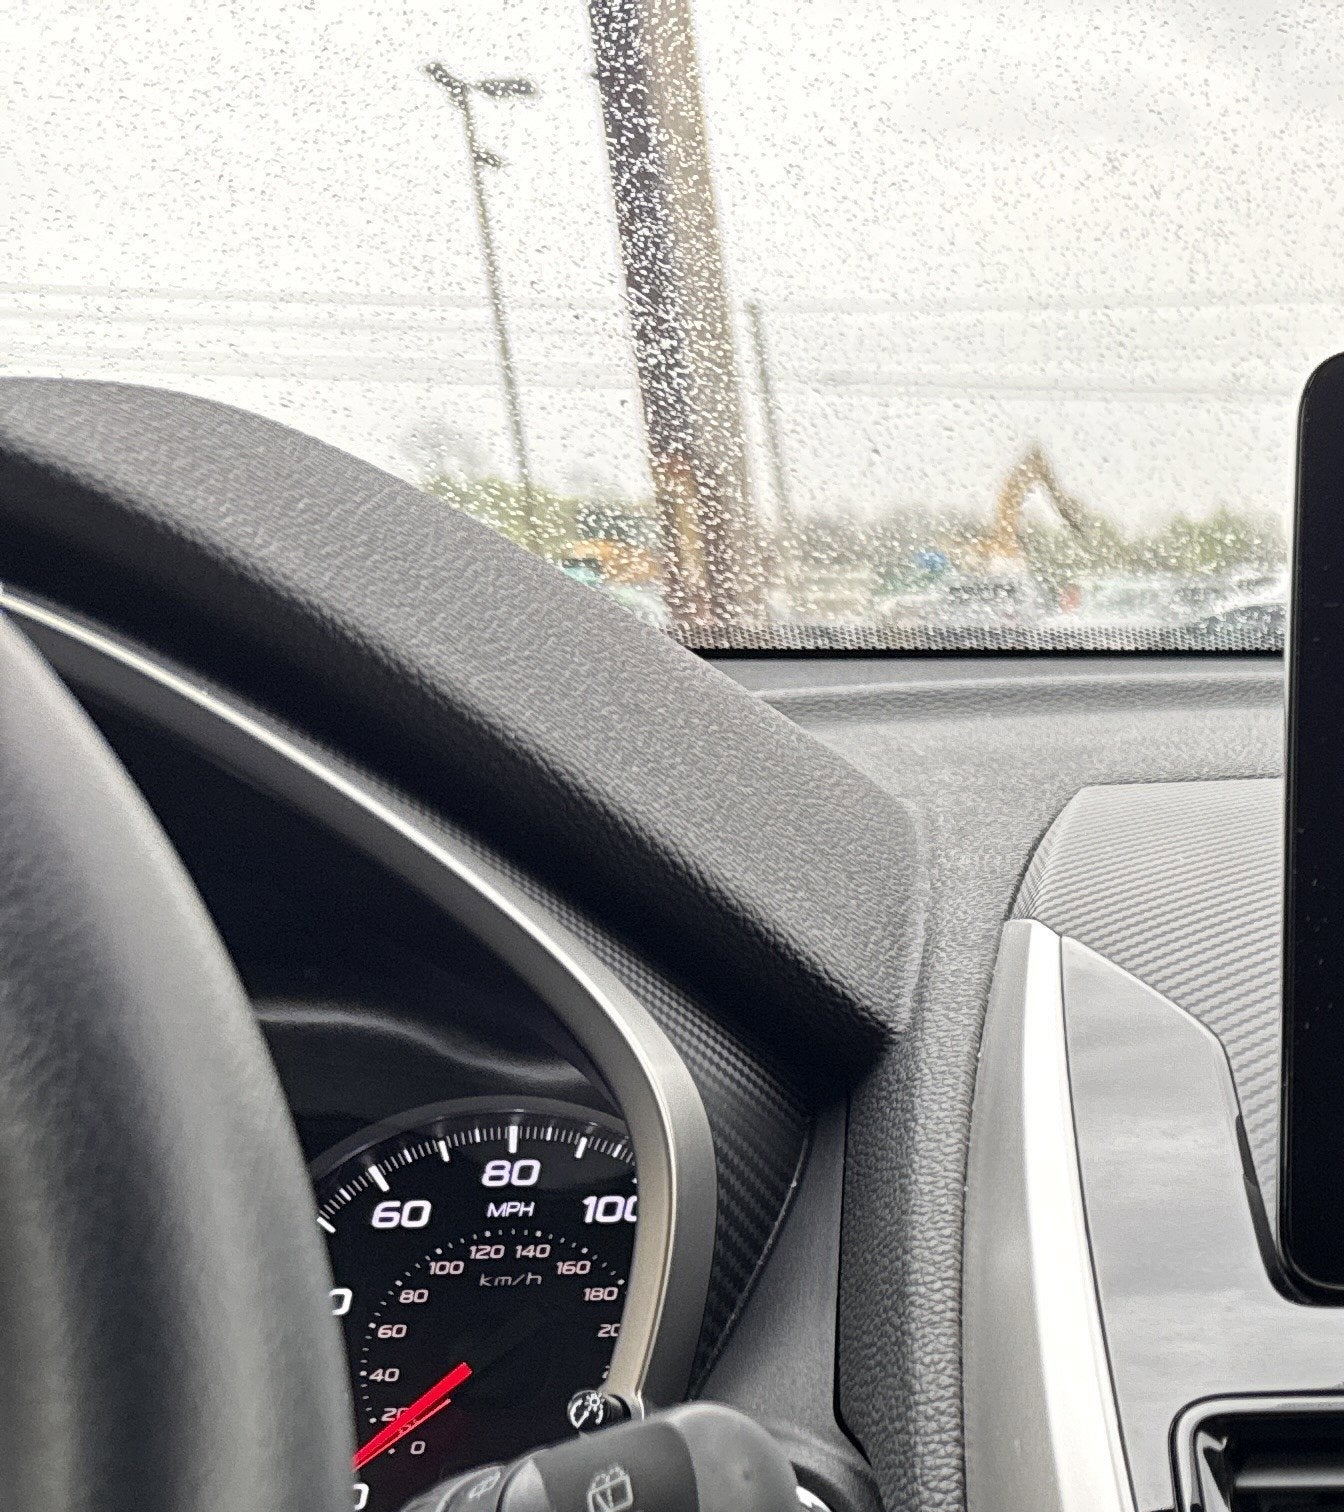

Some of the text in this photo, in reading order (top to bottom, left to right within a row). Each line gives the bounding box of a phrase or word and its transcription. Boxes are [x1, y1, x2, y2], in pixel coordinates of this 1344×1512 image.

[481, 1159, 541, 1187] 80
[371, 1199, 432, 1229] 60
[486, 1201, 535, 1218] MPH
[469, 1244, 506, 1260] 120
[515, 1243, 551, 1259] 140
[429, 1260, 465, 1275] 100
[556, 1260, 592, 1275] 160
[479, 1271, 543, 1287] km/h
[399, 1289, 429, 1304] 80
[584, 1286, 619, 1301] 180
[377, 1324, 408, 1339] 60
[368, 1367, 400, 1382] 40
[409, 1440, 426, 1455] 0
